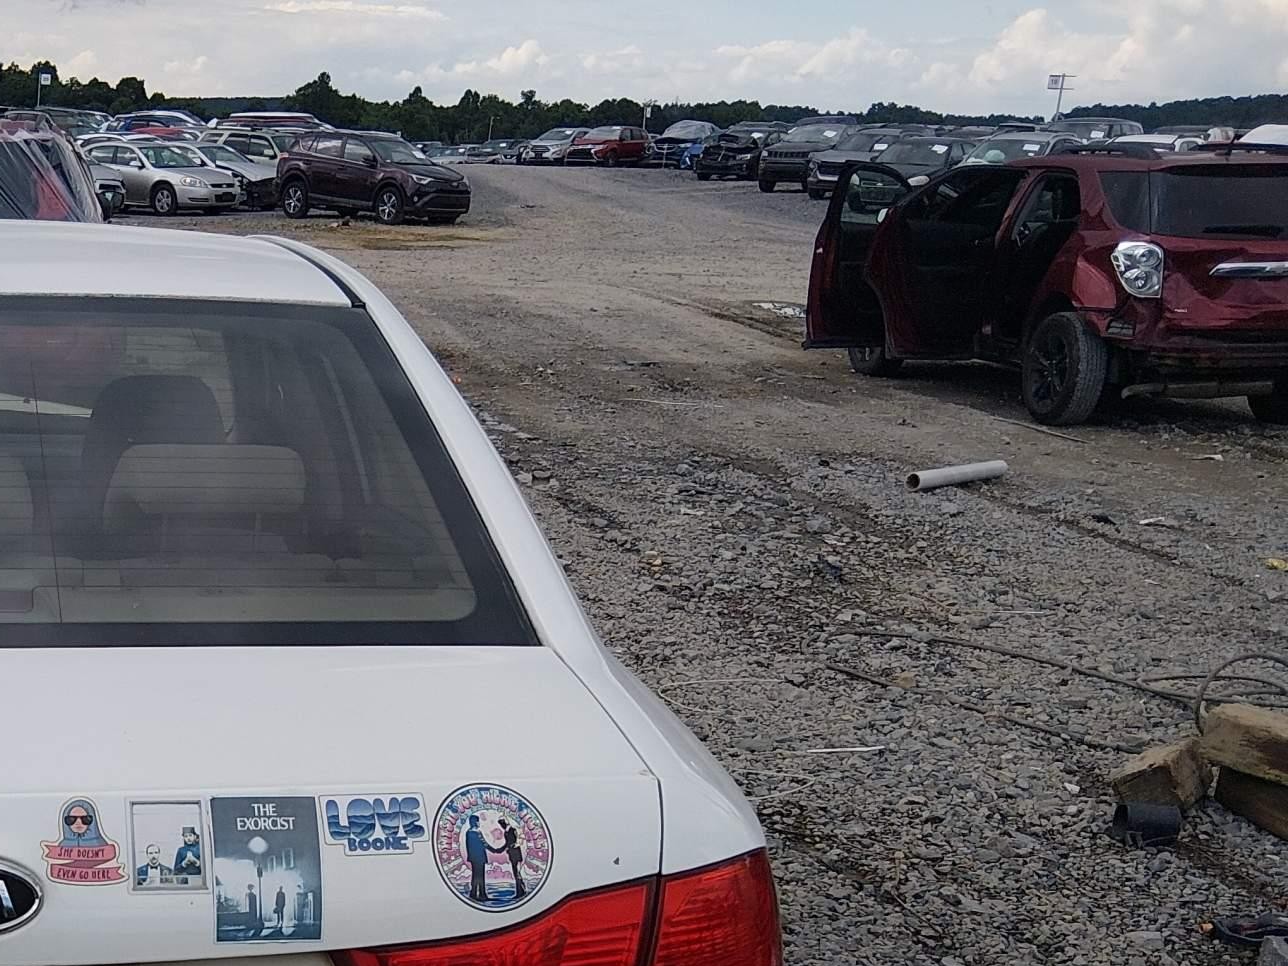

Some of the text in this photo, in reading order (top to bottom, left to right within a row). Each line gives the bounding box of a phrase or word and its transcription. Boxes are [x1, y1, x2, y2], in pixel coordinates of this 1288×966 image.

[251, 803, 278, 817] THE
[236, 817, 295, 831] EXORCIST
[326, 797, 425, 840] LOVE
[58, 847, 73, 857] SHE
[57, 868, 76, 879] EVEN
[79, 870, 89, 880] GO
